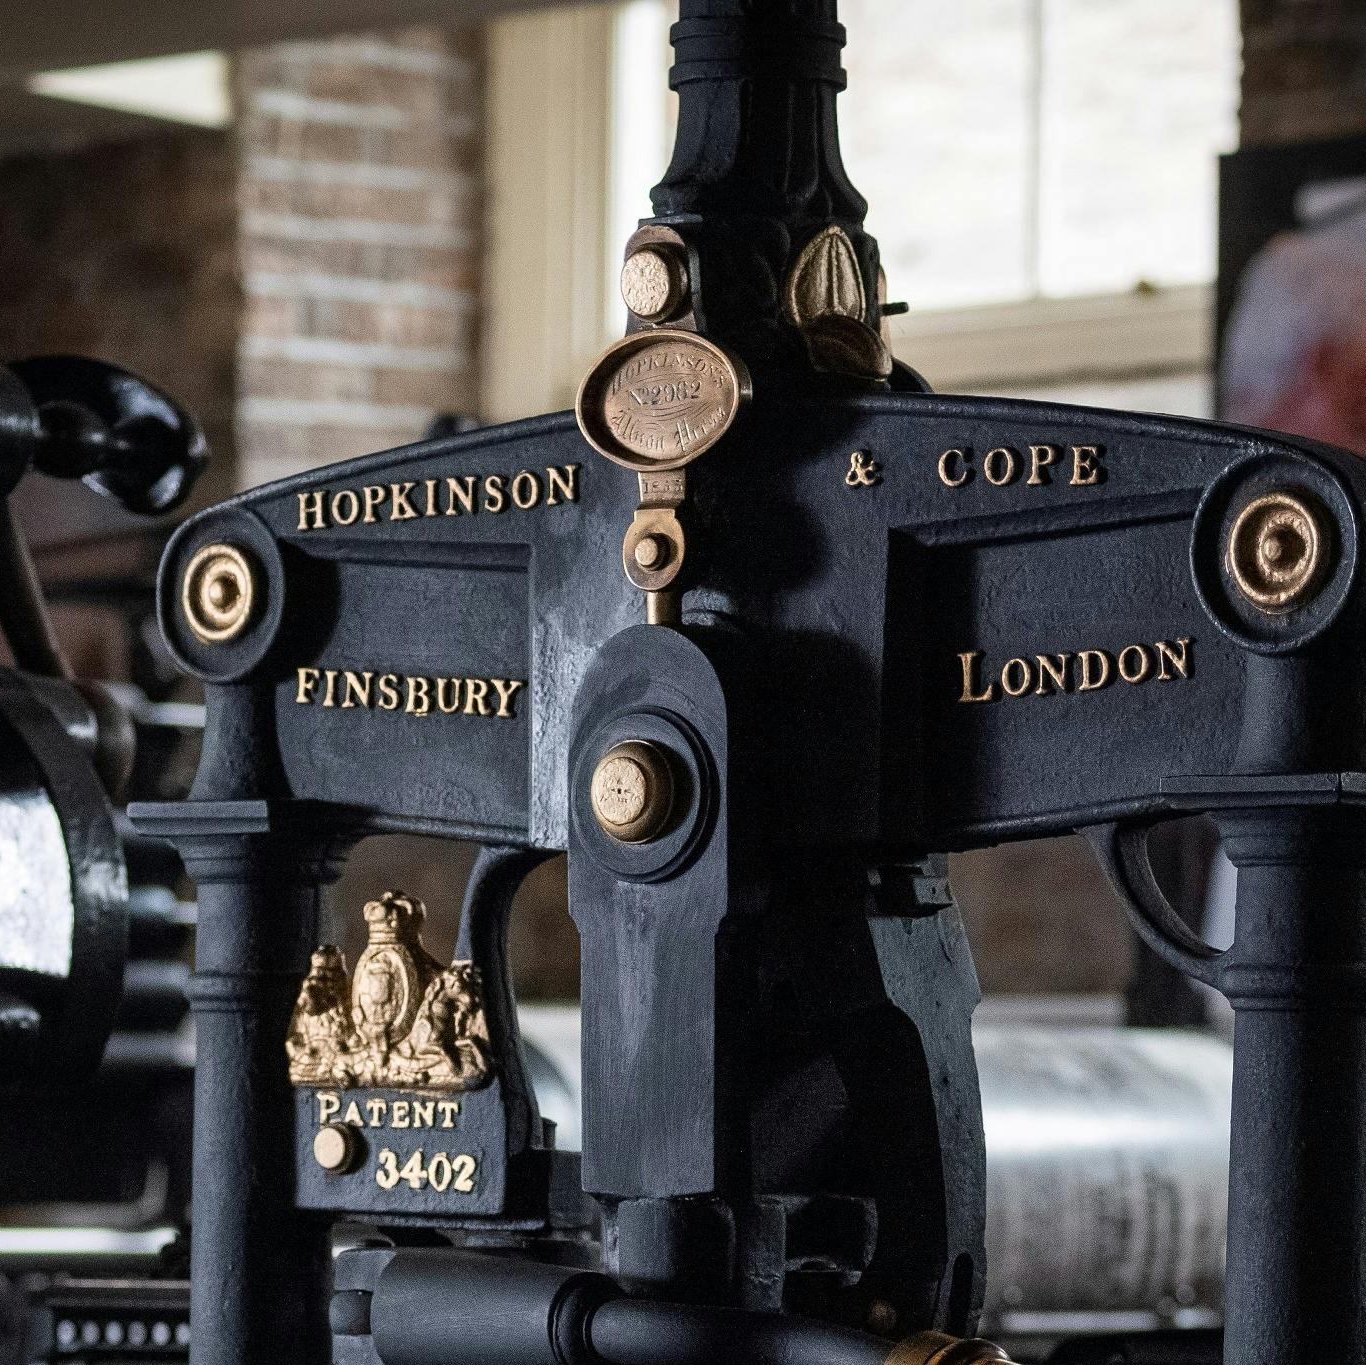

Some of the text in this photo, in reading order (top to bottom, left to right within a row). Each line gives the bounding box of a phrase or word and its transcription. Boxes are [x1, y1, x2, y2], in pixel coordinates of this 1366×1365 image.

[295, 444, 1105, 531] HOPKINSON & COPE
[295, 667, 524, 718] FINSBURY
[955, 636, 1196, 703] LONDON
[316, 1091, 460, 1129] PATENT
[375, 1148, 477, 1192] 3402
